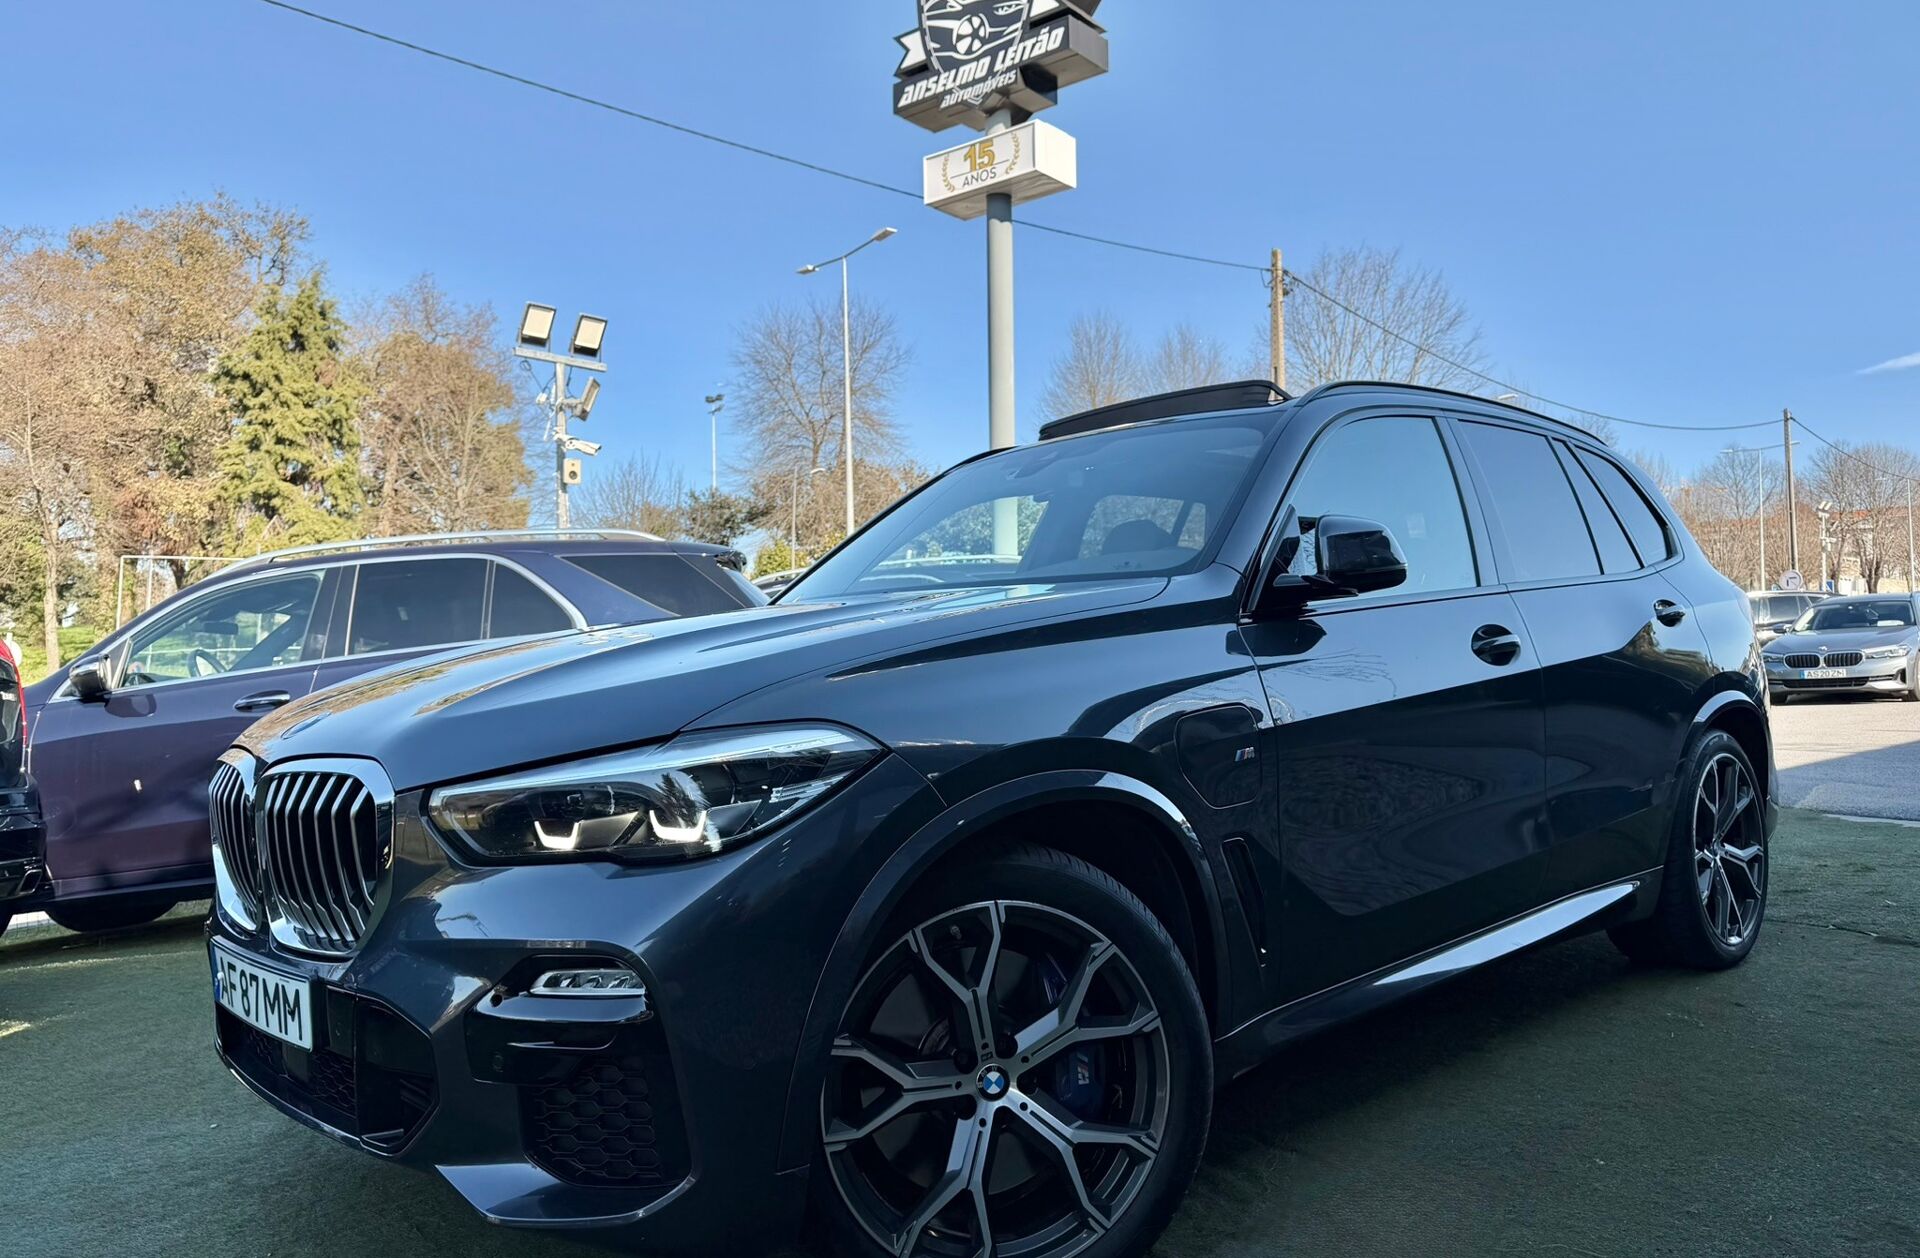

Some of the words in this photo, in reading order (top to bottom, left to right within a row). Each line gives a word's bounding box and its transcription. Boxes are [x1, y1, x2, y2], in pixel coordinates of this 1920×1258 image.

[898, 56, 991, 108] ANSELMO
[994, 26, 1065, 71] LEITÃO
[963, 140, 996, 172] 15
[963, 167, 997, 188] ANOS
